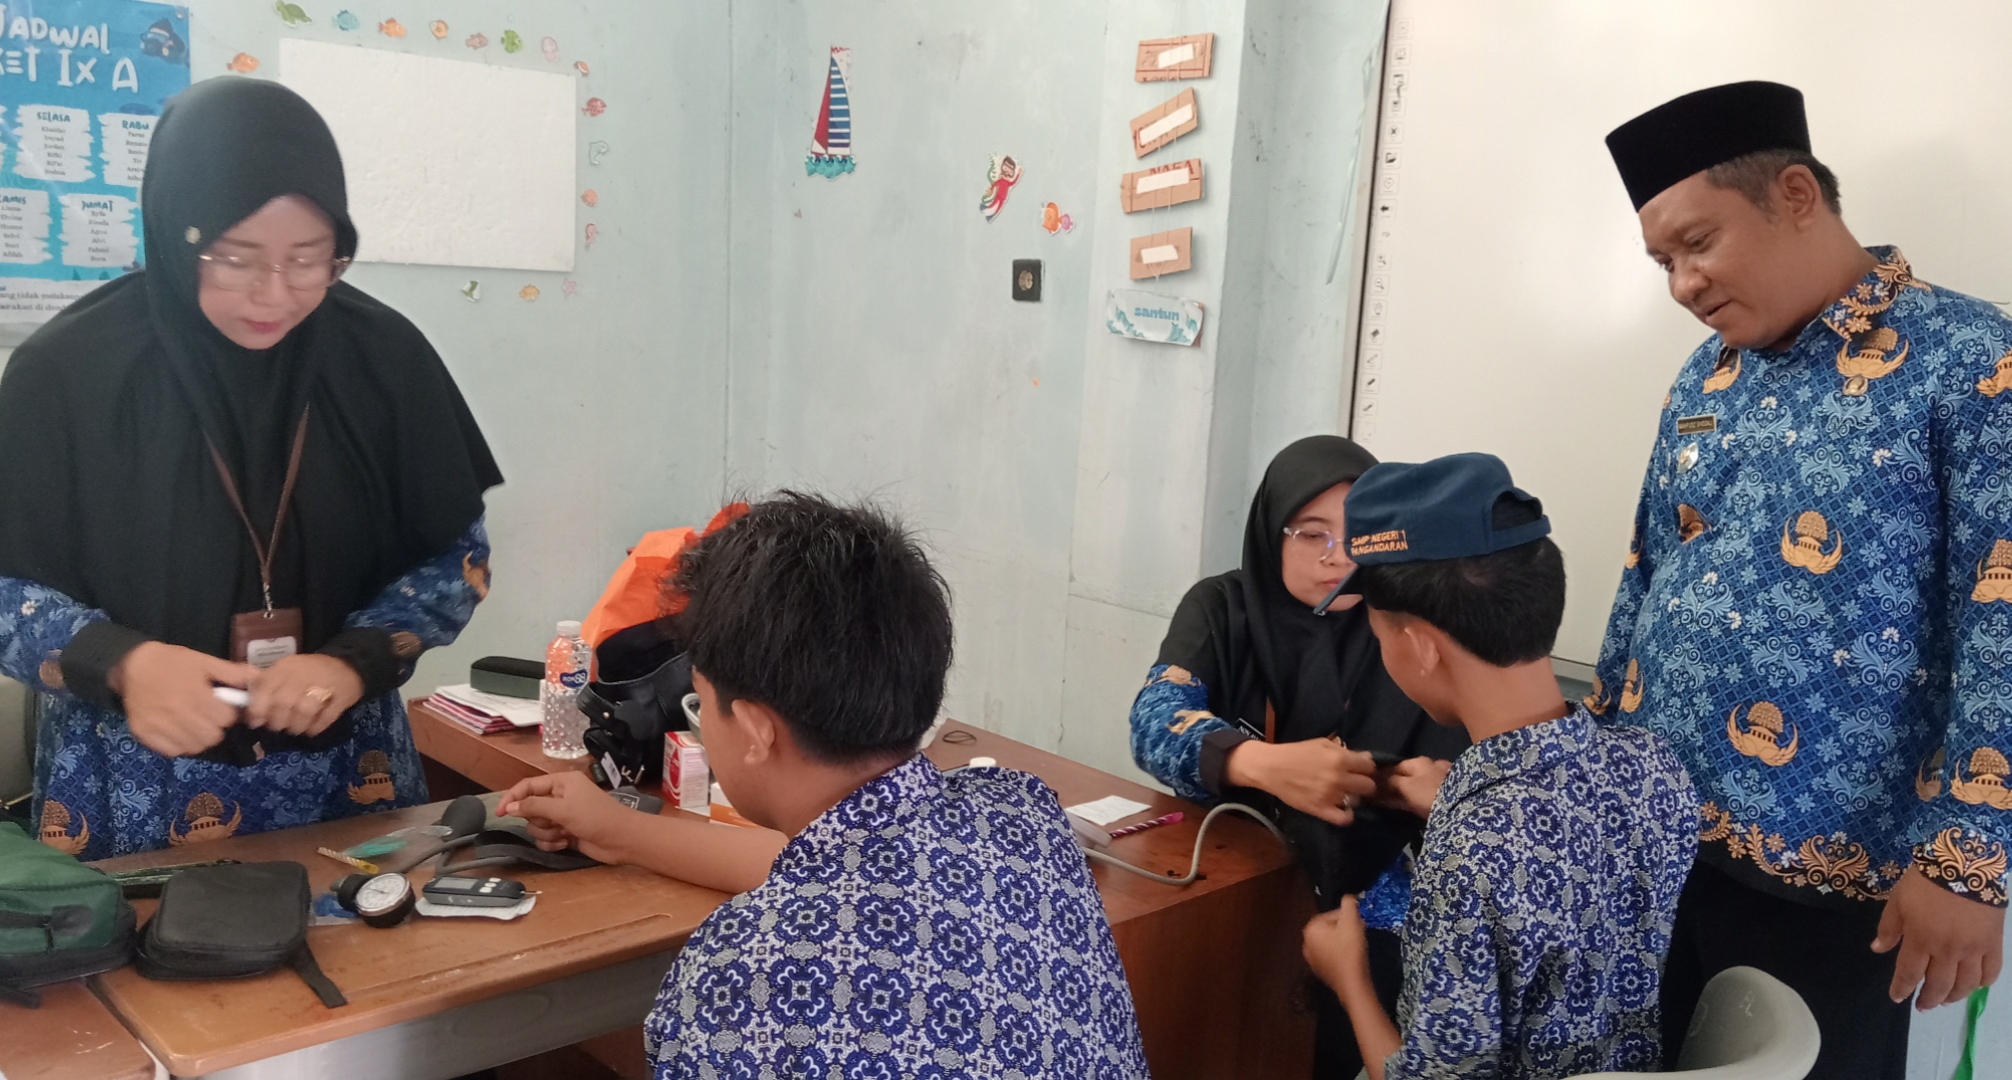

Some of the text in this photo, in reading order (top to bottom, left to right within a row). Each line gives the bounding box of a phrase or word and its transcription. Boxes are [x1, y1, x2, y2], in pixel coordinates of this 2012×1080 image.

[112, 57, 138, 93] A
[37, 112, 71, 123] SELASA
[17, 291, 39, 299] tidak
[1135, 307, 1180, 321] santun
